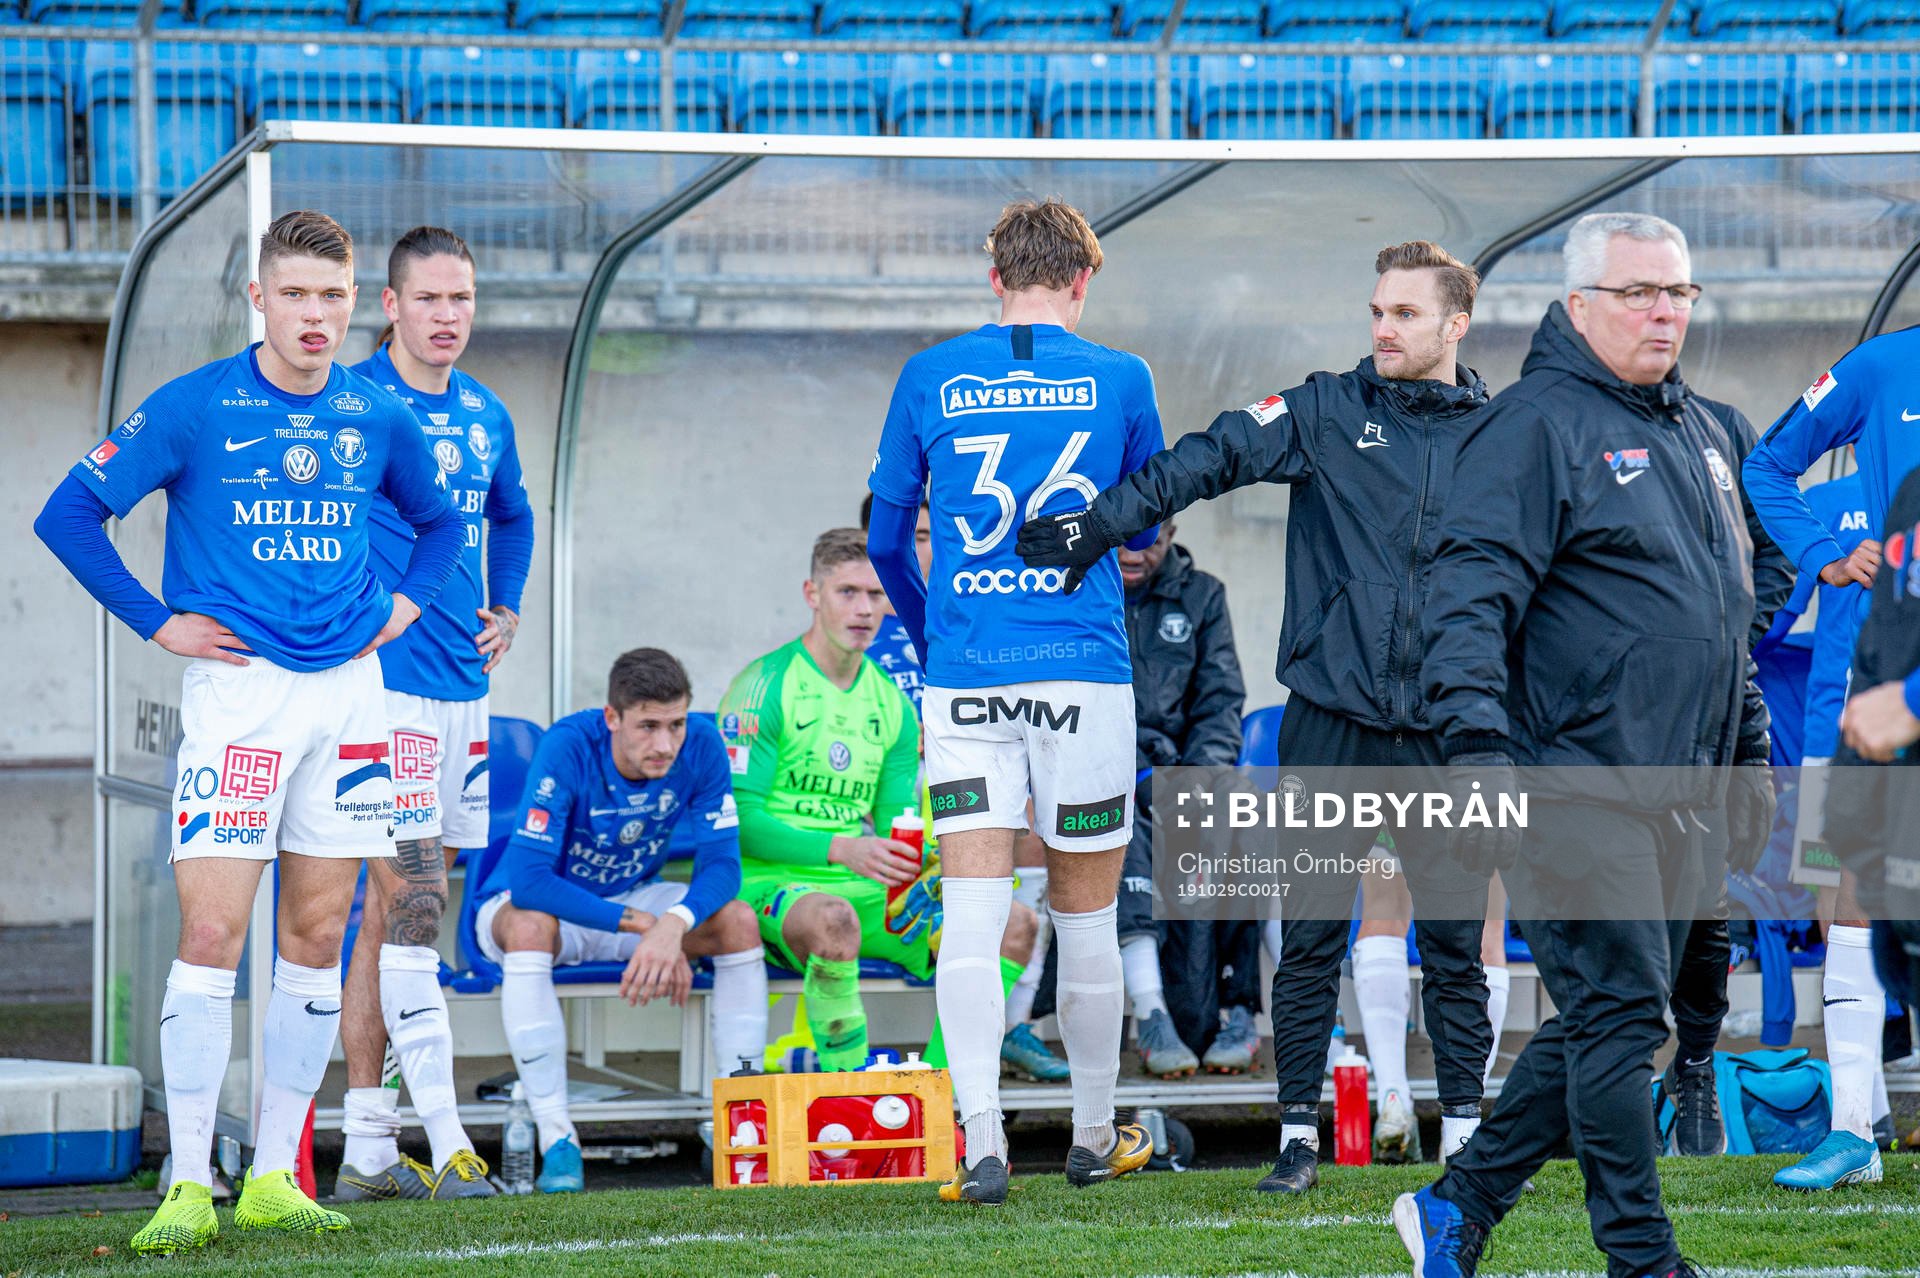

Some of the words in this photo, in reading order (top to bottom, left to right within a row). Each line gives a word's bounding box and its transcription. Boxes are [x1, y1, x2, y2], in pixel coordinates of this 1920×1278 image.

[222, 399, 269, 407] exakta
[949, 387, 1089, 411] ÄLVSBYHUS
[274, 429, 328, 440] TRELLEBORG
[1364, 421, 1388, 443] FL
[92, 467, 107, 482] SPEL
[953, 431, 1100, 556] 36
[232, 500, 357, 527] MELLBY
[1839, 511, 1869, 532] AR
[252, 529, 342, 562] GÅRD
[1062, 521, 1082, 551] FL
[950, 696, 1081, 734] CMM
[179, 766, 219, 802] 20
[785, 769, 878, 801] MELLBY
[334, 801, 382, 812] Trelleborgs
[396, 792, 437, 809] NTER
[931, 792, 957, 813] kea
[215, 810, 268, 827] INTER
[1063, 810, 1110, 832] akea
[213, 827, 267, 845] SPORT
